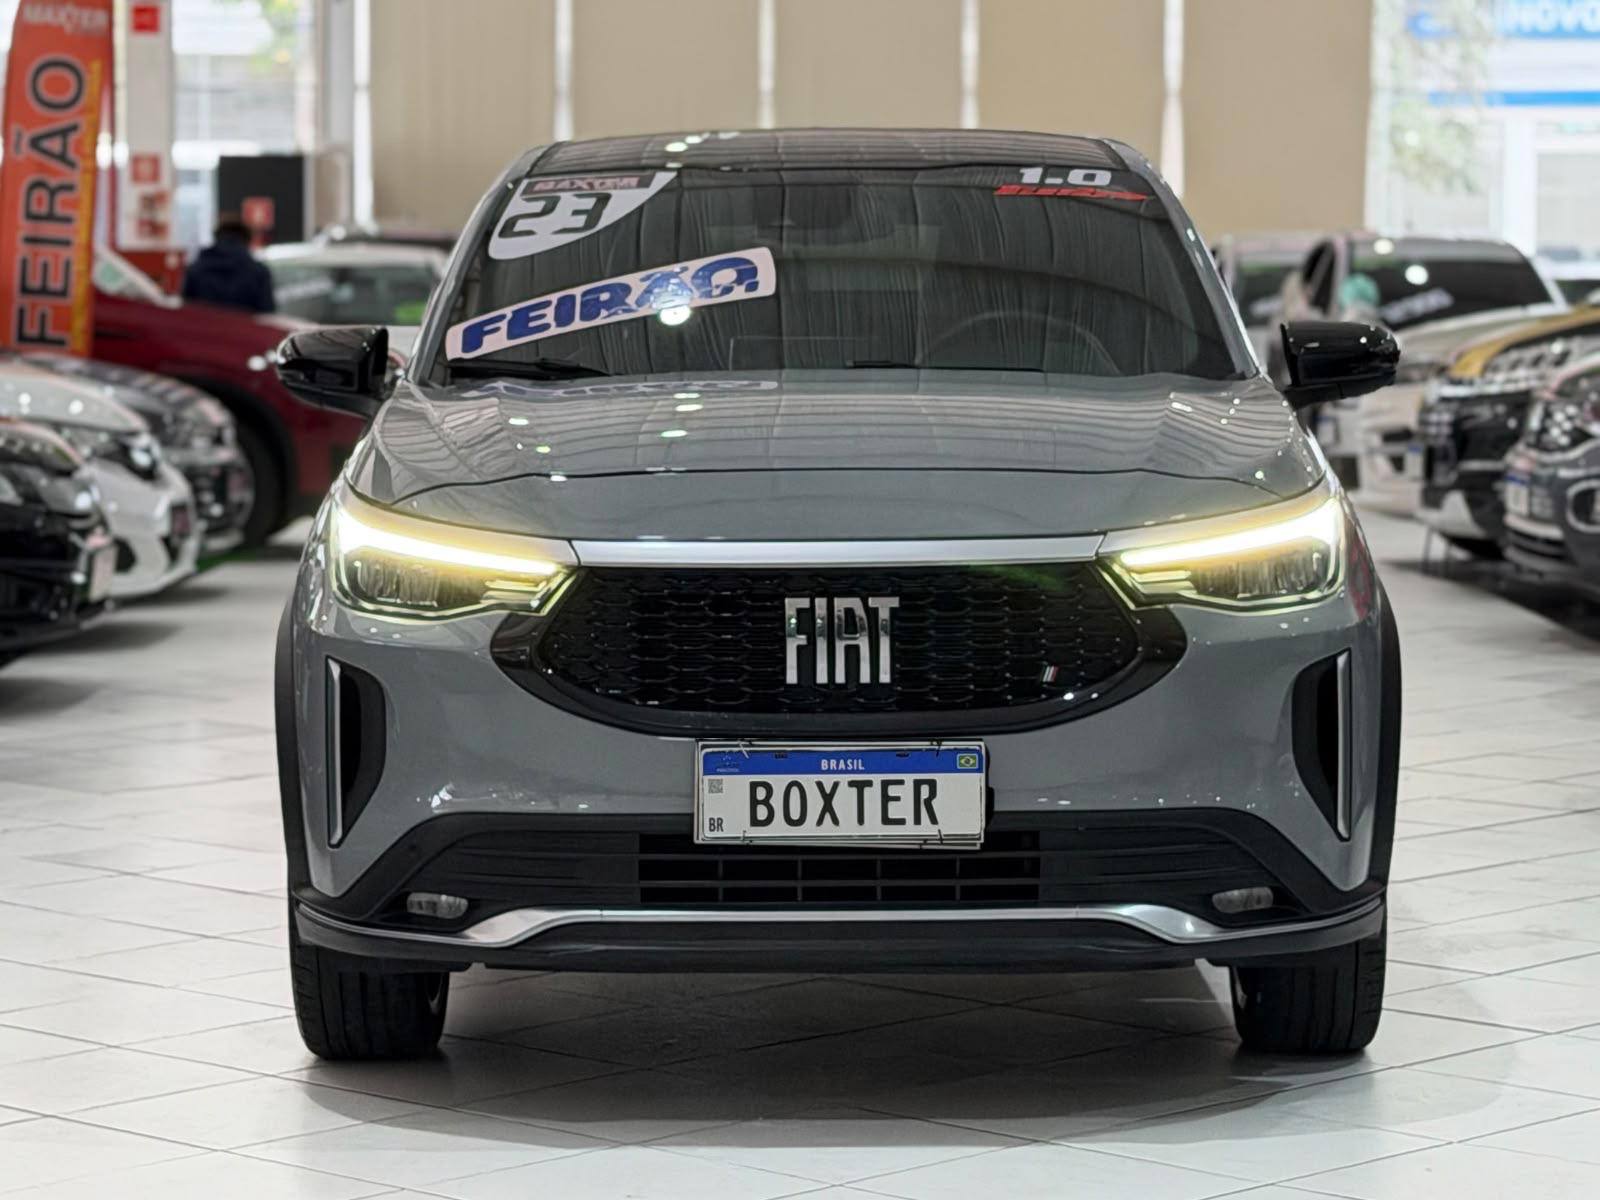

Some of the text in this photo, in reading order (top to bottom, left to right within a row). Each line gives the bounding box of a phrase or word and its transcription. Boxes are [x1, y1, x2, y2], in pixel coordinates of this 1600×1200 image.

[15, 57, 85, 348] FEIRÃO
[497, 192, 613, 239] 23
[461, 256, 760, 354] FEIRÃO
[784, 596, 900, 684] FIAT
[820, 758, 866, 771] BRASIL
[708, 816, 725, 833] BR
[748, 778, 939, 828] BOXTER
